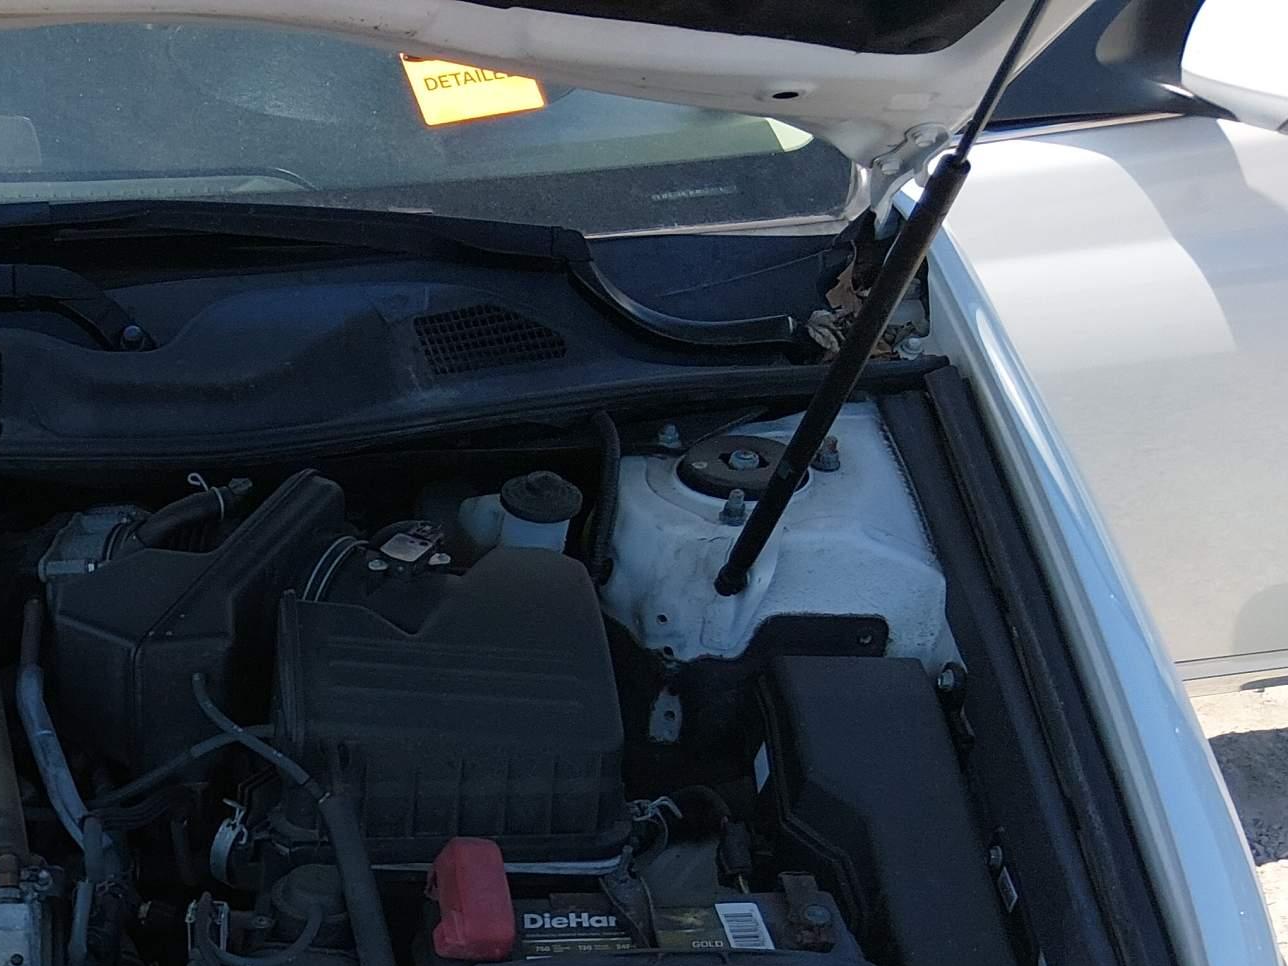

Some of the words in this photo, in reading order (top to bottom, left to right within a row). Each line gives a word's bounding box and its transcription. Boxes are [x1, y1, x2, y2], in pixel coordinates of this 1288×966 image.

[424, 69, 507, 91] DETAILE
[524, 912, 617, 929] DieHar
[691, 940, 724, 948] GOLD
